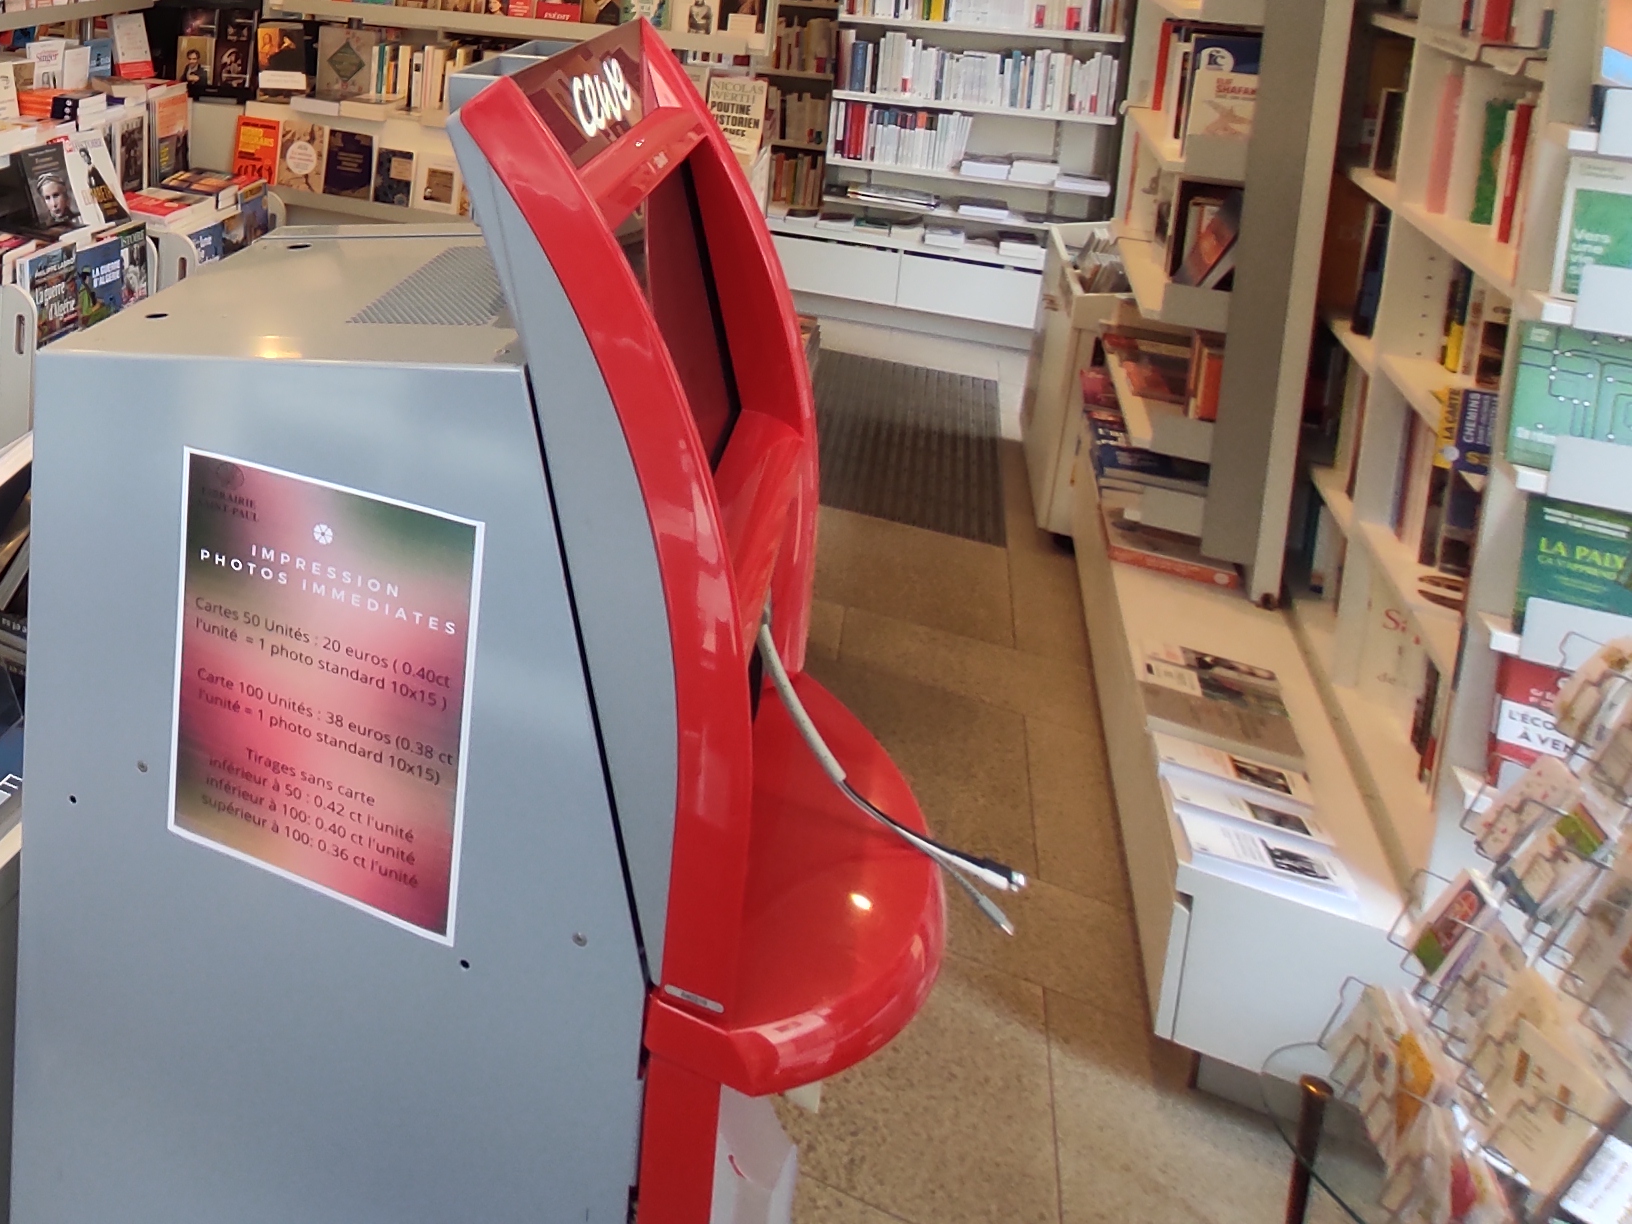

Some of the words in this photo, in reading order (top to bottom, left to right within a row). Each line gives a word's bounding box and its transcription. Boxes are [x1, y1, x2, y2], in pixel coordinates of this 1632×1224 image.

[710, 101, 752, 116] POUTINE
[712, 80, 764, 95] NICOLAS
[44, 281, 66, 303] guerre
[251, 543, 399, 598] IMPRESSION
[1538, 536, 1568, 558] LA
[200, 548, 288, 585] PHOTOS
[302, 578, 456, 636] IMMEDIATES
[195, 596, 239, 621] Cartes
[243, 611, 260, 627] 50
[264, 616, 310, 644] Unités
[322, 636, 341, 653] 20
[345, 646, 389, 670] euros
[195, 616, 238, 642] l'unité
[270, 641, 314, 667] photo
[317, 657, 385, 690] standard
[390, 679, 437, 707] 10x15
[197, 666, 234, 691] Carte
[239, 681, 264, 700] 100
[267, 691, 314, 719] Unités
[325, 711, 344, 729] 38
[348, 720, 392, 746] euros
[395, 733, 434, 760] (0.38
[438, 750, 454, 767] ct
[197, 687, 241, 713] l'unité
[269, 712, 312, 739] photo
[315, 729, 383, 764] standard
[389, 751, 441, 786] 10x15)
[1508, 707, 1556, 732] L'ÉCO
[1537, 733, 1572, 754] VEN
[208, 754, 268, 789] inférieur
[284, 782, 303, 801] 50
[313, 794, 345, 818] 0.42
[348, 809, 363, 825] ct
[366, 814, 415, 844] l'unité
[245, 746, 296, 778] Tirages
[300, 770, 334, 792] sans
[337, 785, 376, 808] carte
[200, 793, 267, 830] supérieur
[284, 823, 314, 849] 100:
[317, 837, 350, 862] 0.36
[352, 853, 367, 871] ct
[370, 858, 419, 890] l'unité
[206, 775, 265, 810] inférieur
[282, 802, 311, 825] 100:
[314, 816, 347, 840] 0.40
[350, 830, 364, 847] ct
[367, 836, 417, 867] l'unité
